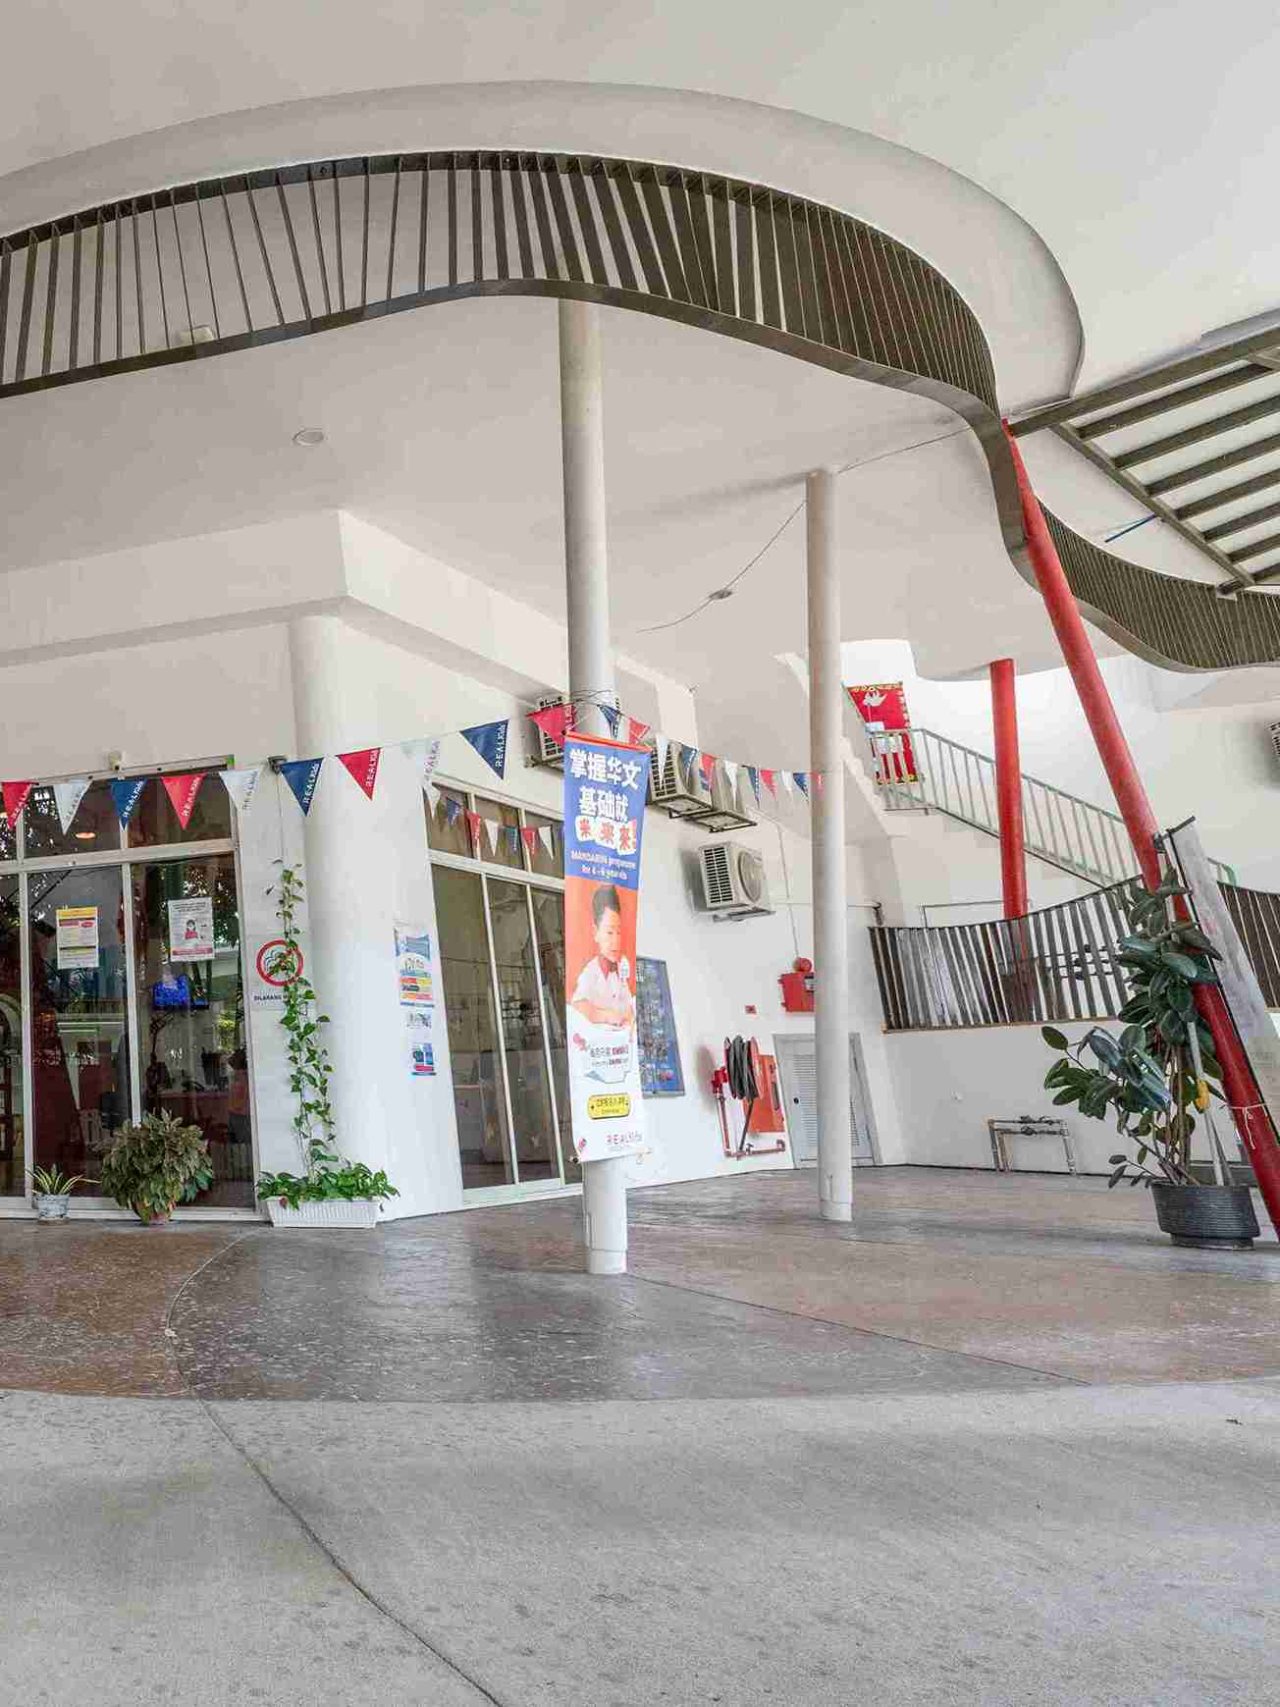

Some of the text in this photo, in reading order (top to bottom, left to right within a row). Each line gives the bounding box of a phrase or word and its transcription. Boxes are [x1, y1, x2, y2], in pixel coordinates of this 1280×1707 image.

[570, 748, 642, 790] 掌握华文
[579, 785, 629, 822] 基础就
